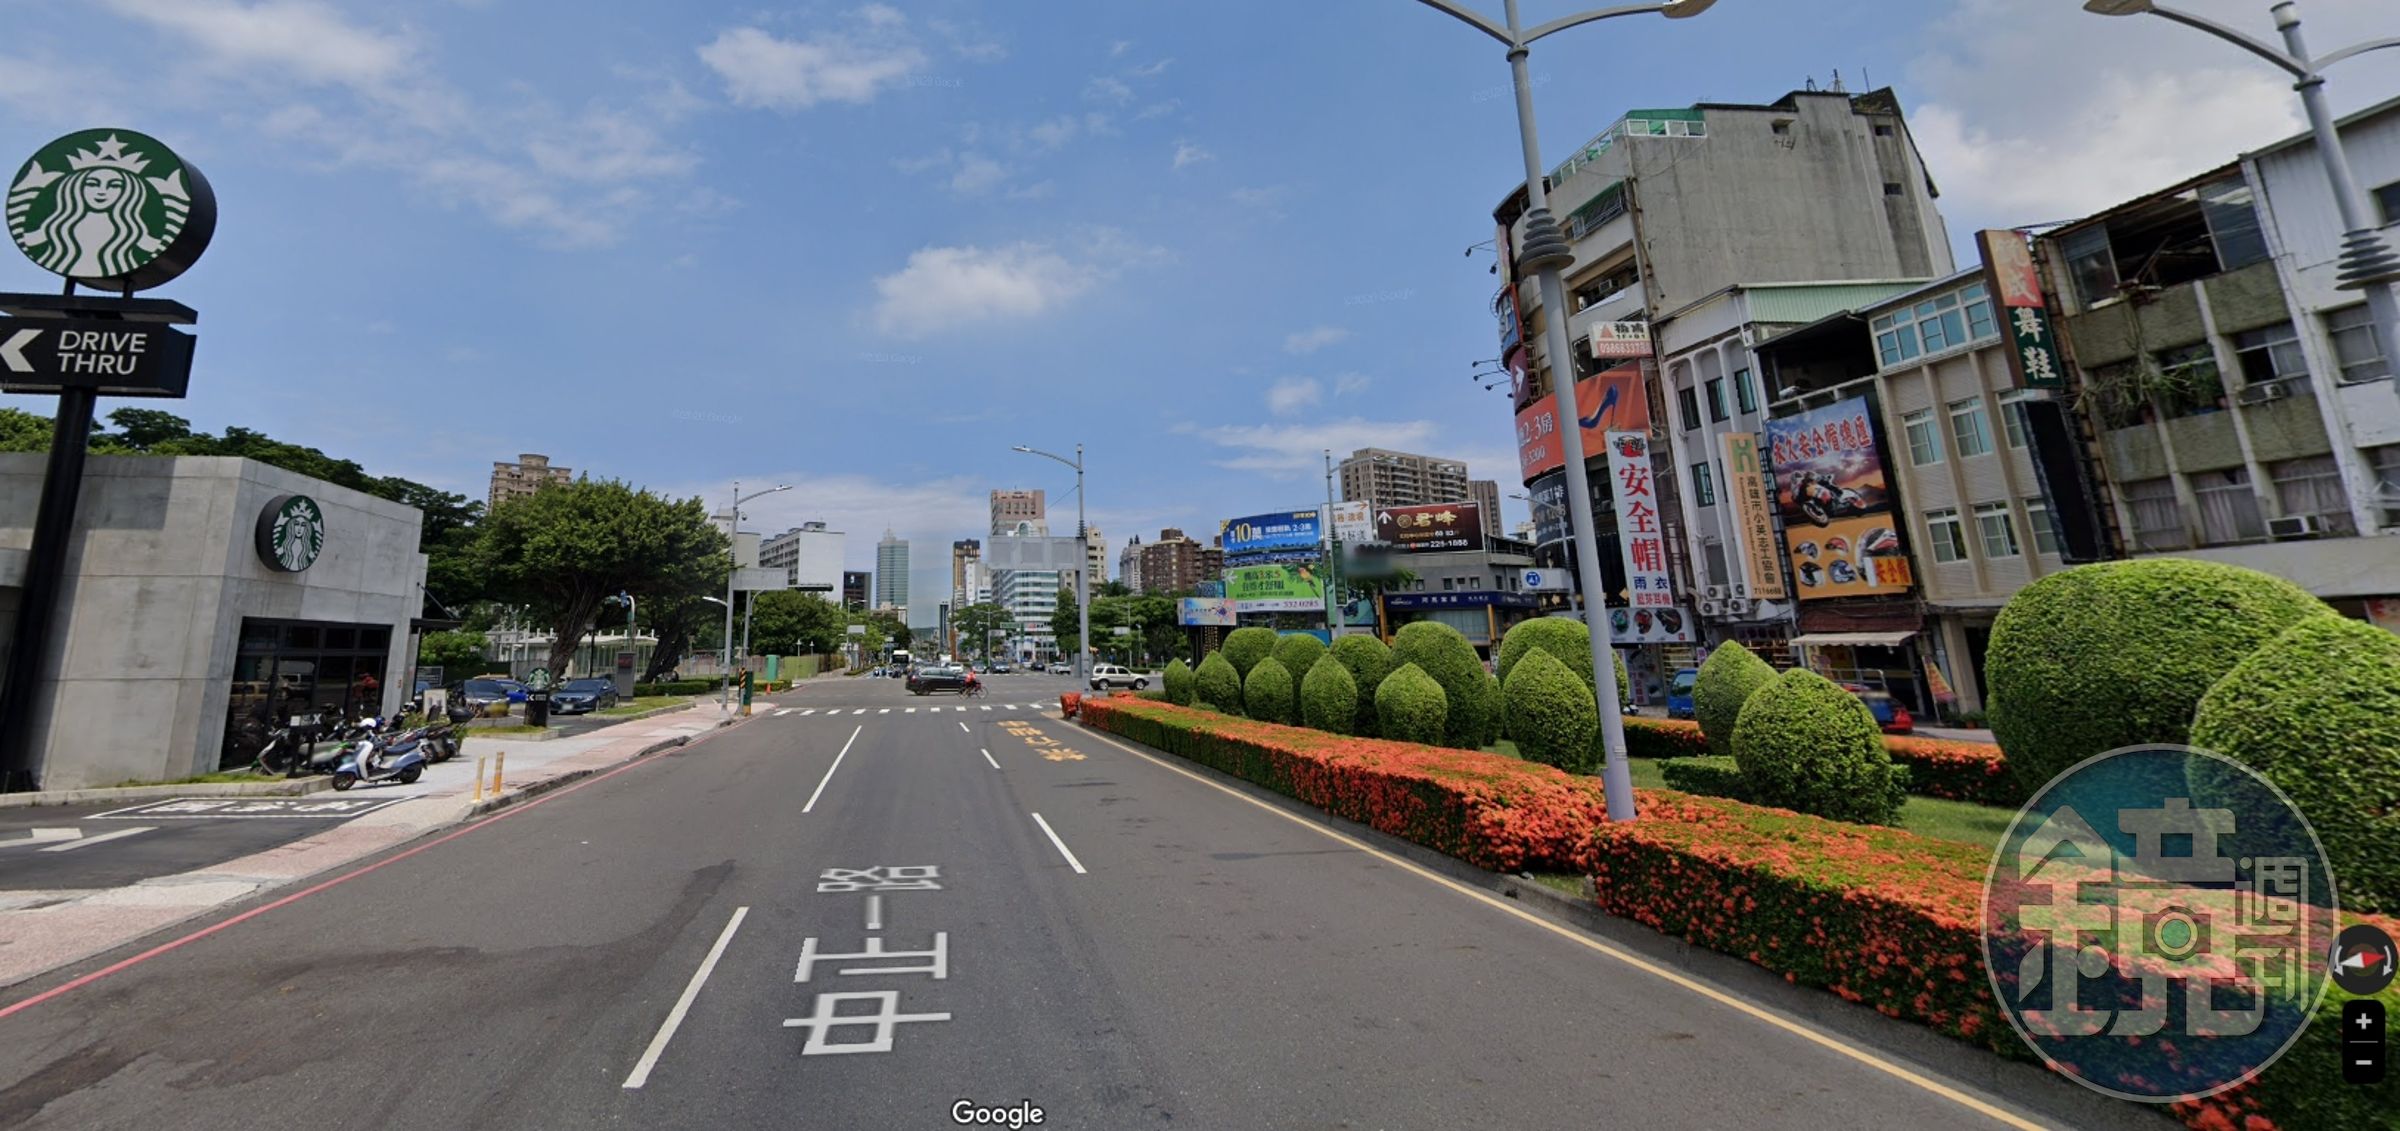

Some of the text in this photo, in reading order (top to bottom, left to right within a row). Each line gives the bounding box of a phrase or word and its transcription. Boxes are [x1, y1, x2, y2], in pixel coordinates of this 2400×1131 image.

[58, 330, 147, 355] DRIVE
[57, 352, 137, 376] THRU
[1773, 414, 1873, 465] 永久安全帽總匯
[1413, 510, 1458, 527] 君峰
[1618, 463, 1663, 572] 安全帽
[1747, 475, 1776, 584] 高雄市小英志工協會
[1634, 576, 1669, 590] 雨衣
